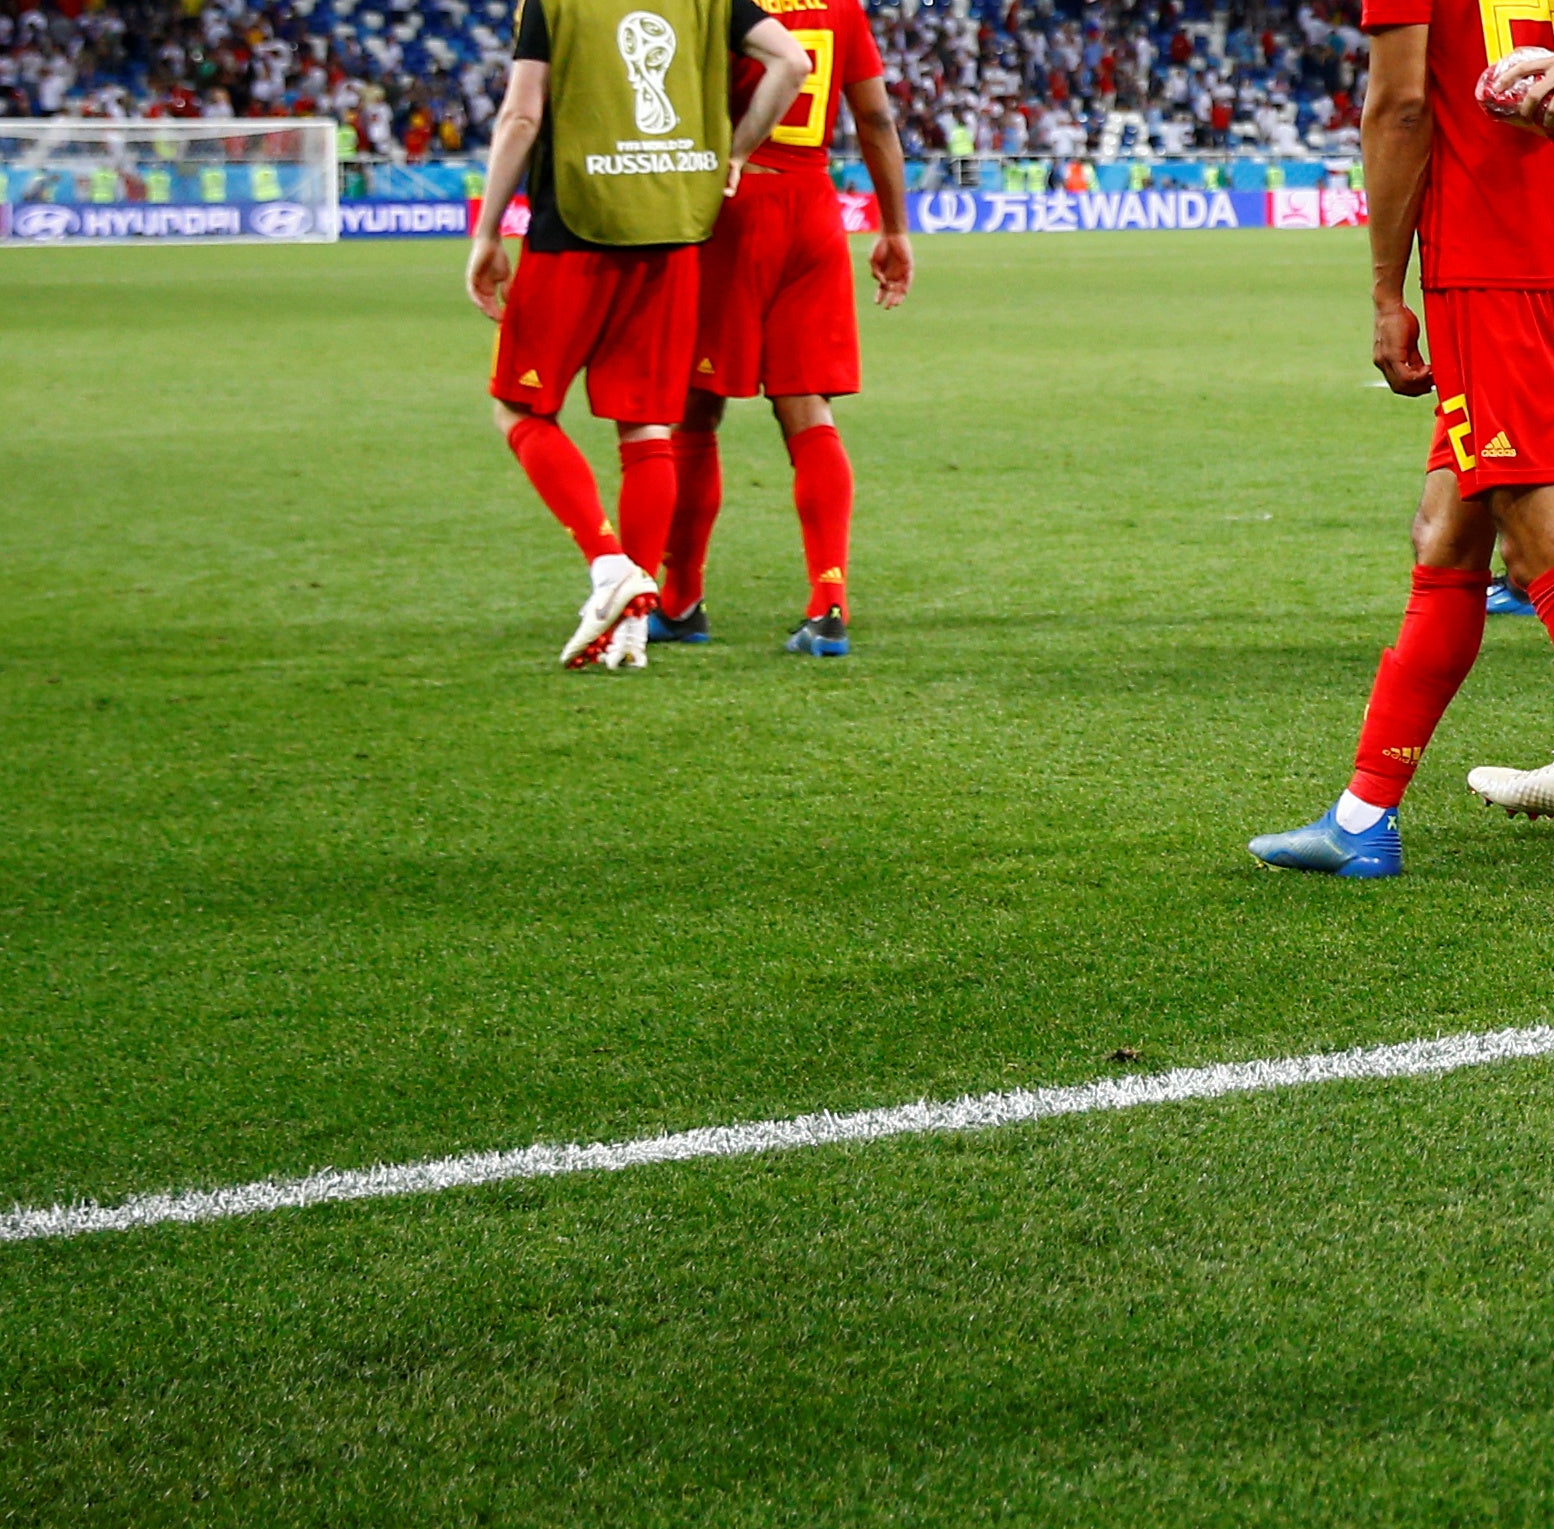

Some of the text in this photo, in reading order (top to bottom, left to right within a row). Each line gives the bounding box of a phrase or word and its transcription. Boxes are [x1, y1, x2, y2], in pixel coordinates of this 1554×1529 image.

[585, 150, 720, 176] RUSSIA 2018
[81, 205, 240, 236] HYUNDAI
[983, 190, 1240, 232] 万达 WANDA
